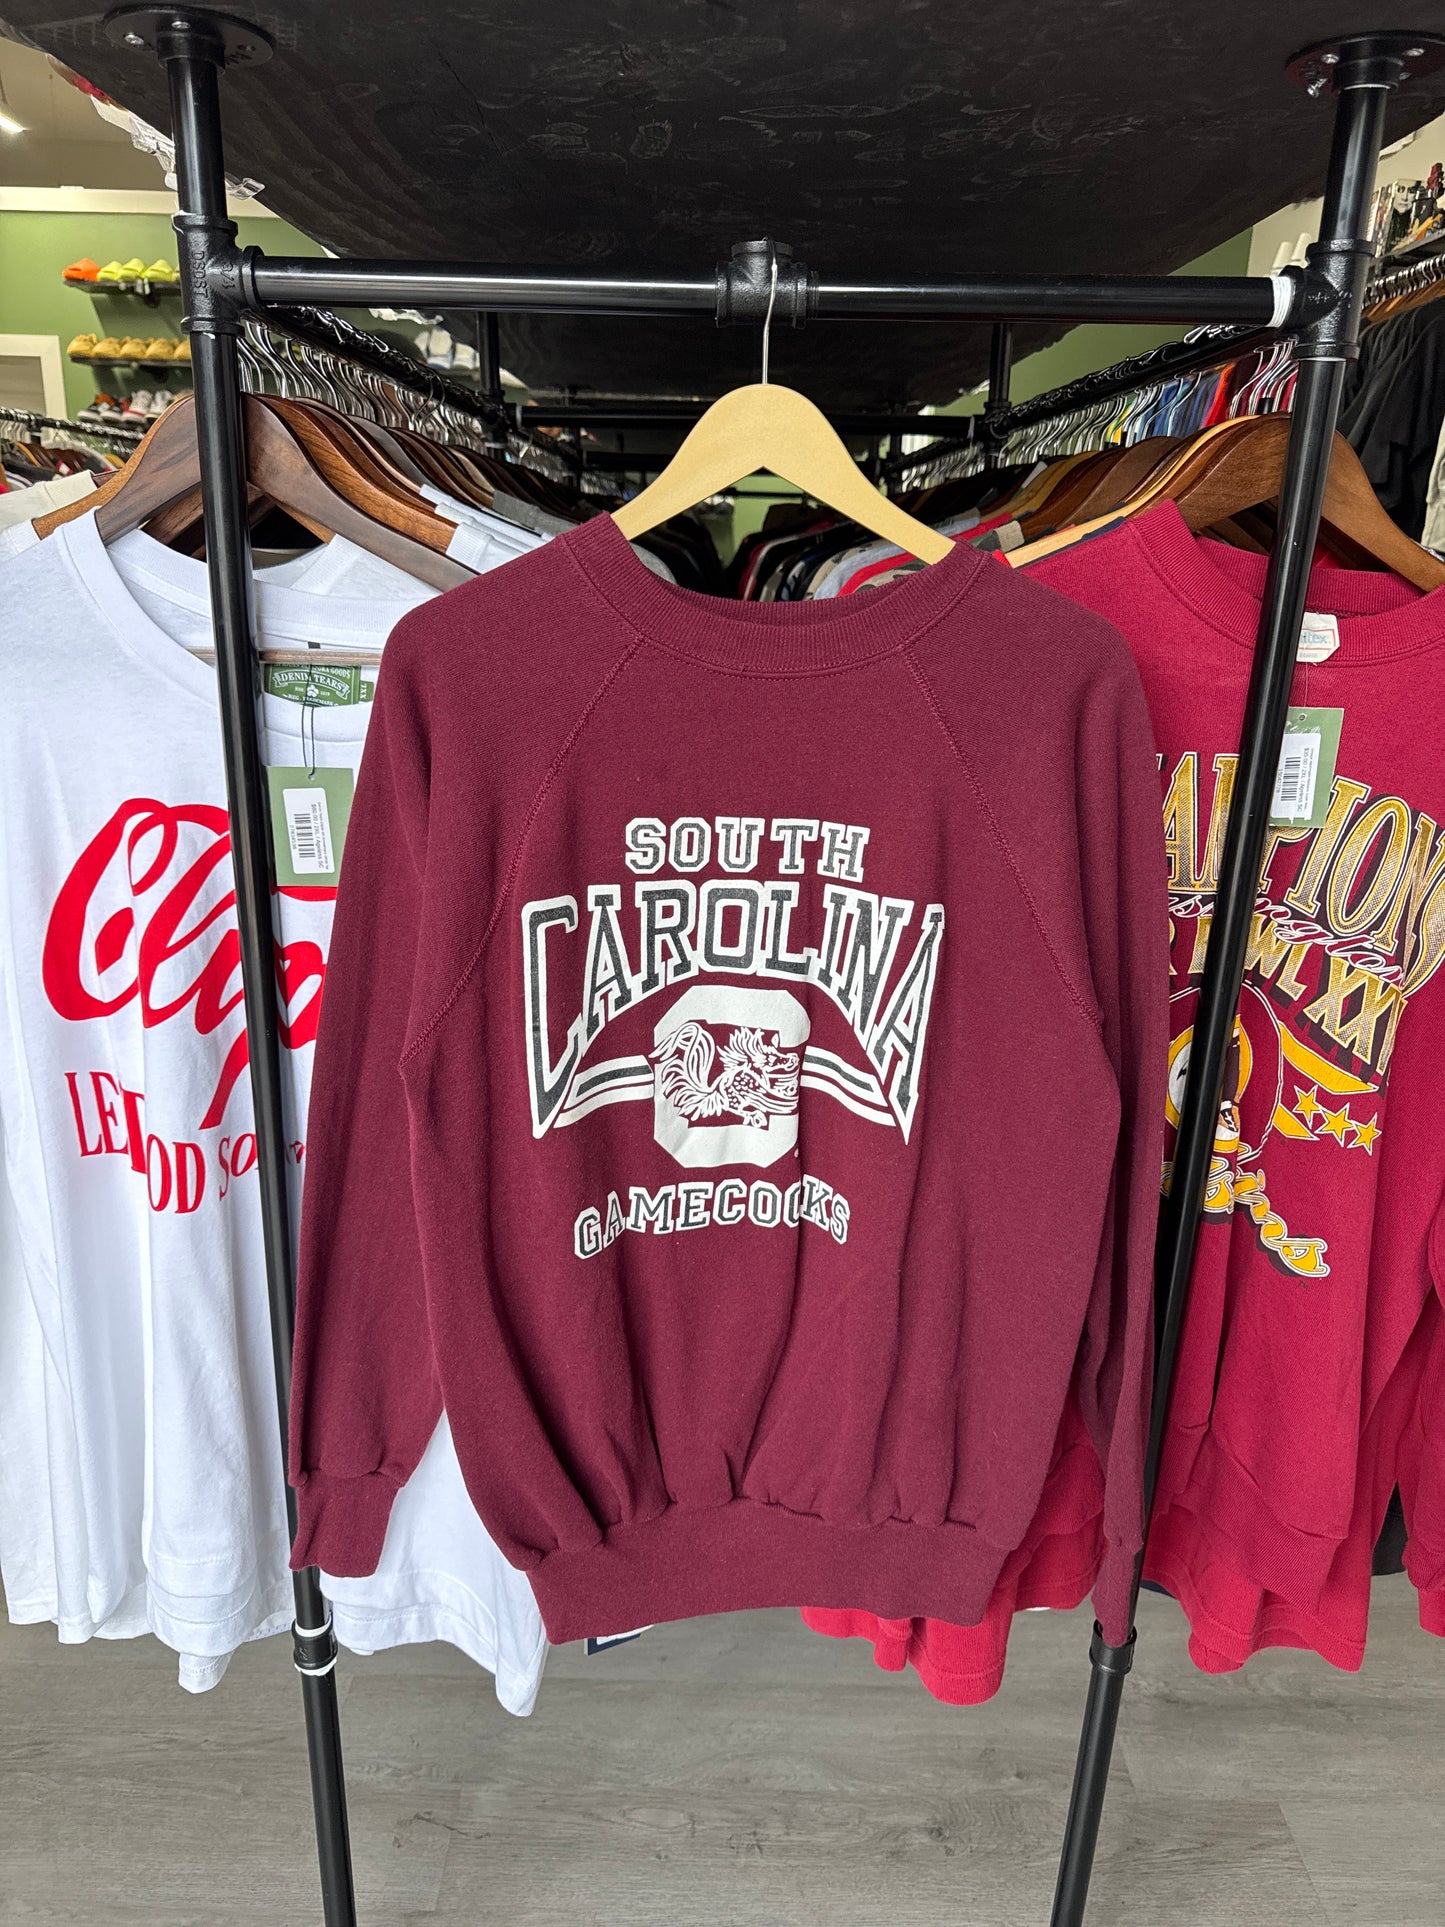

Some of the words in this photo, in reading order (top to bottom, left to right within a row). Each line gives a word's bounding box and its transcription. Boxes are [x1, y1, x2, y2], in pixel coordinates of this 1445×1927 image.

[281, 672, 312, 682] DENIM
[314, 674, 344, 691] TEARS
[625, 816, 872, 883] SOUTH
[520, 879, 946, 1146] CAROLINA
[145, 1133, 206, 1215] OD
